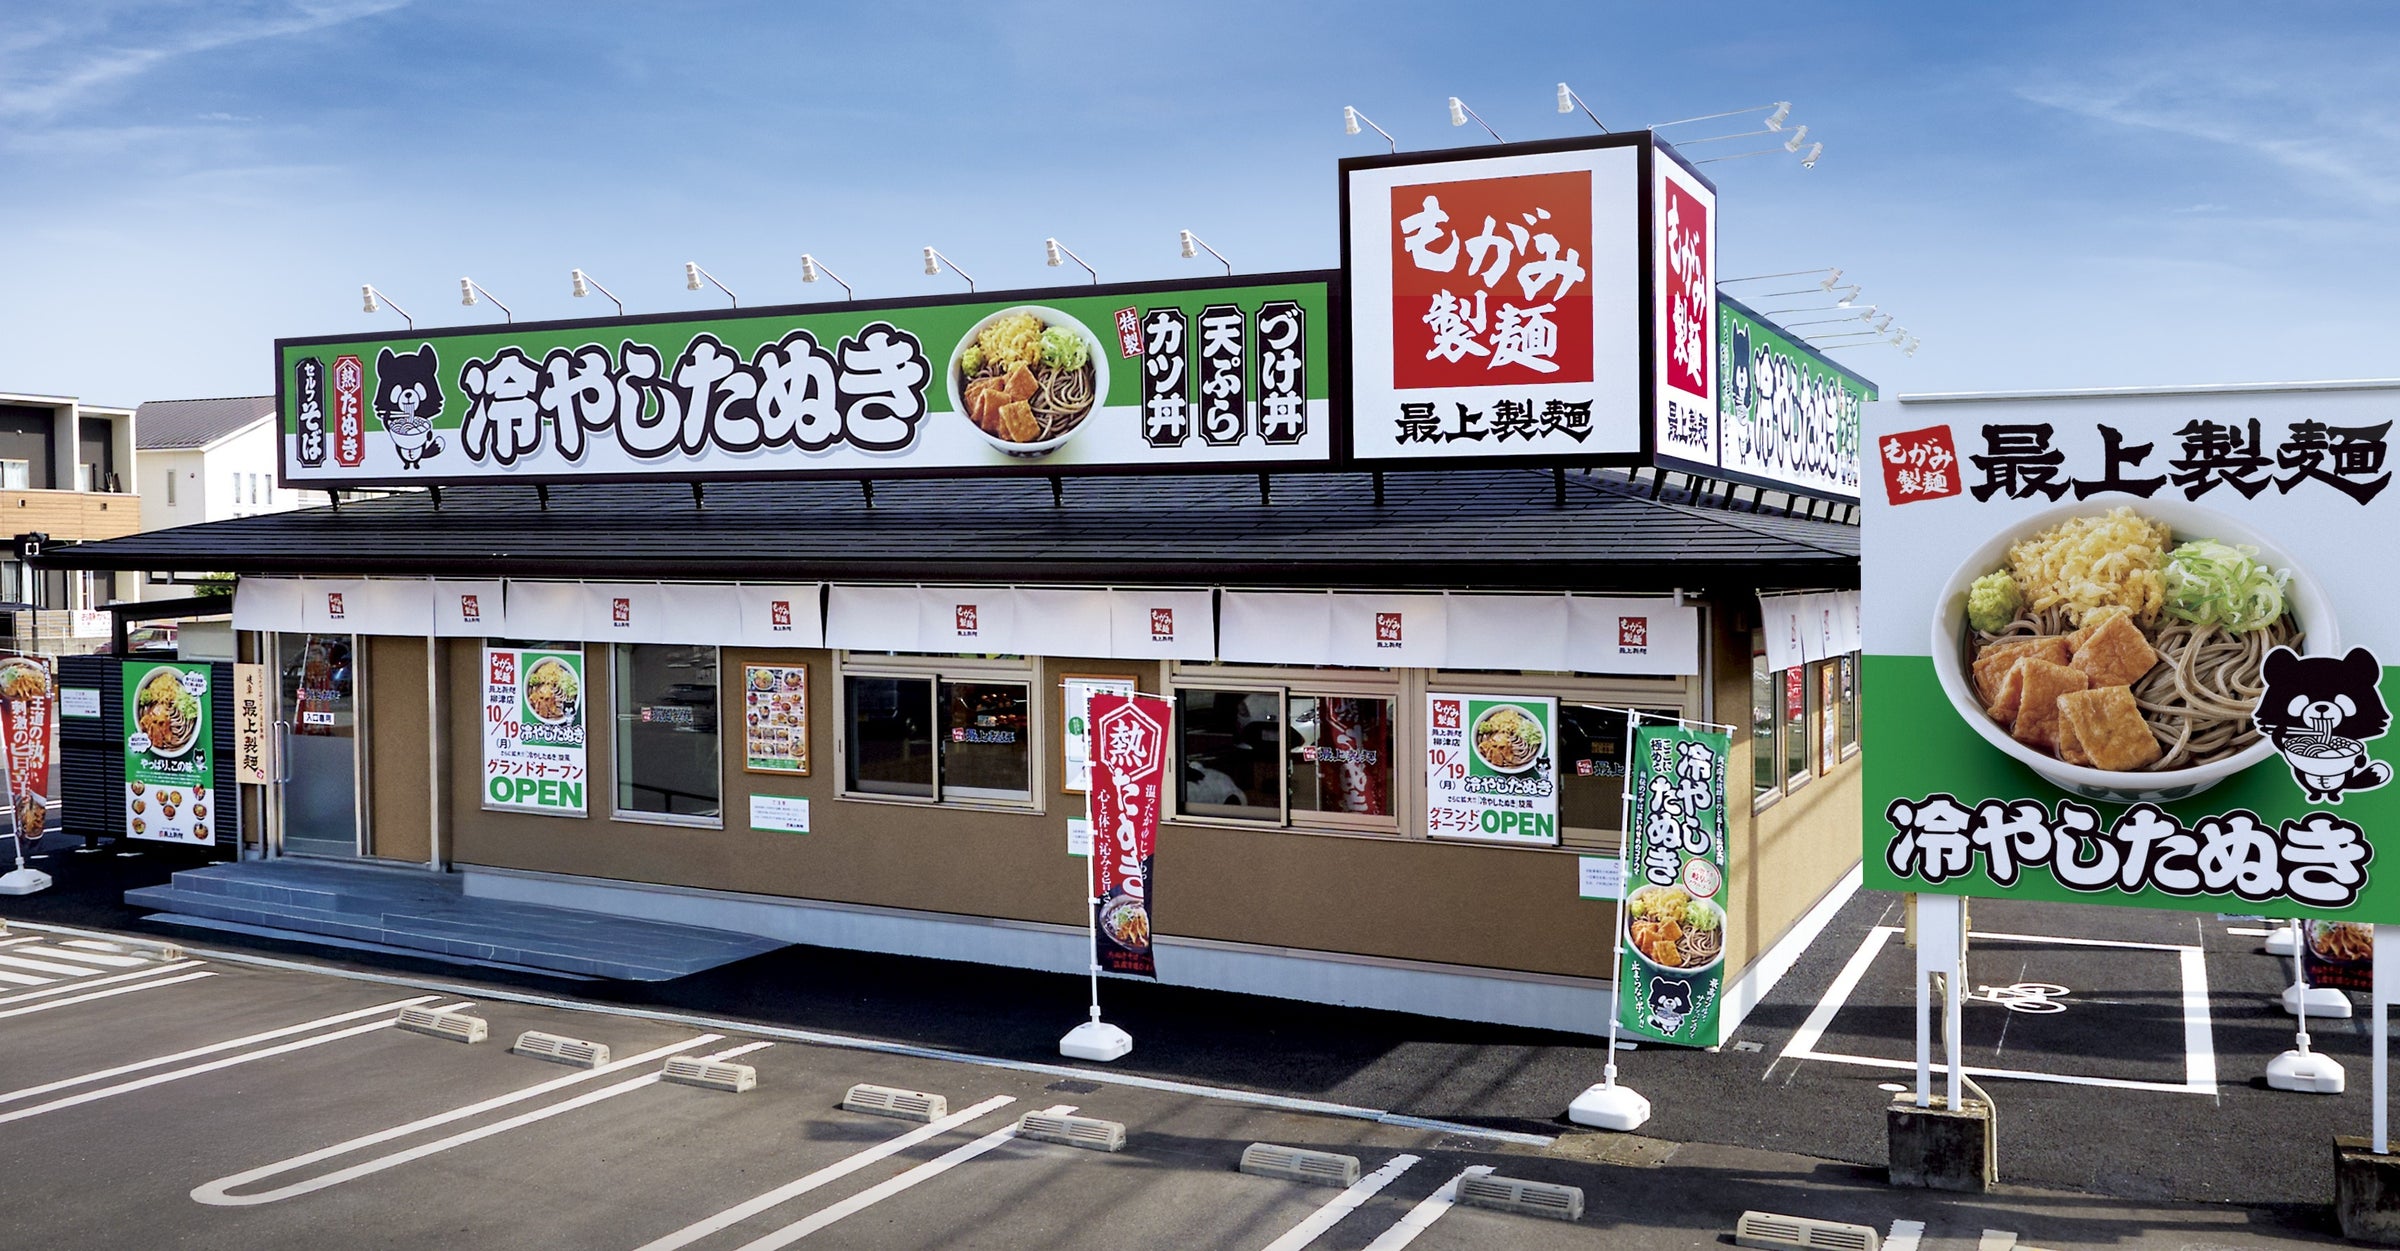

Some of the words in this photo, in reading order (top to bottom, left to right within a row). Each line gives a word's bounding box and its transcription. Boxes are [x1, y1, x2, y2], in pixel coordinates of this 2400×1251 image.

[1400, 195, 1586, 302] もがみ
[1667, 193, 1707, 320] もがみ
[1119, 311, 1141, 355] 特製
[1146, 312, 1186, 438] カツ丼
[1260, 308, 1303, 436] づけ丼
[1421, 289, 1560, 374] 製麺
[300, 363, 323, 461] セルフそば
[462, 324, 930, 464] 冷やしたぬき
[1202, 315, 1242, 440] 天ぷら
[1395, 398, 1594, 445] 最上製麺
[1756, 345, 1837, 480] 冷やしたぬき
[1883, 436, 1954, 467] もがみ
[1897, 468, 1948, 496] 製麺
[1968, 417, 2394, 506] 最上製麺
[487, 759, 584, 780] グランドオープン
[520, 723, 585, 744] 冷やしたぬき
[489, 776, 583, 809] OPEN
[1430, 807, 1480, 821] グランド
[1465, 775, 1553, 797] 冷やしたぬき
[1481, 809, 1554, 837] OPEN
[1676, 741, 1714, 855] 冷やし
[1644, 775, 1683, 887] たぬき
[1886, 793, 2375, 908] 冷やしたぬき
